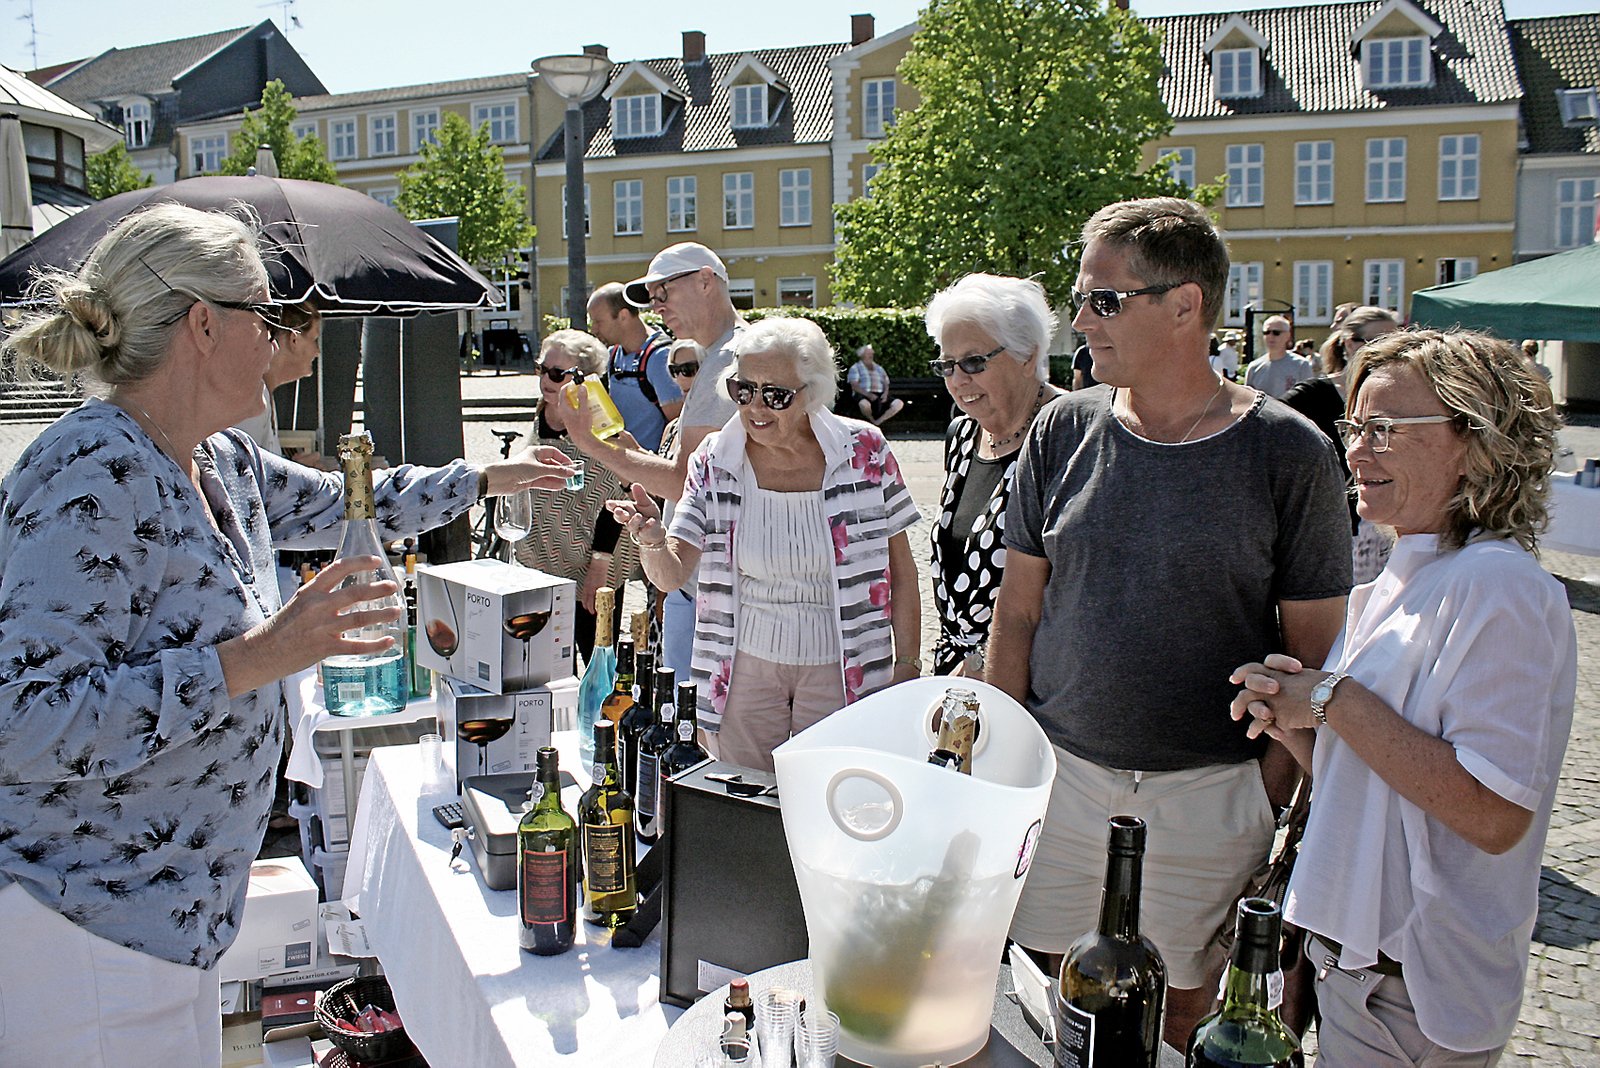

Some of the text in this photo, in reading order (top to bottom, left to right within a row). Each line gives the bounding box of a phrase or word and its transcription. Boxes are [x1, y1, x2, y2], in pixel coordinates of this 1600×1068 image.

[467, 592, 491, 608] PORTO
[518, 699, 544, 707] PORTO
[287, 953, 309, 961] ZWIESEL
[282, 970, 341, 984] garciacarrion.com
